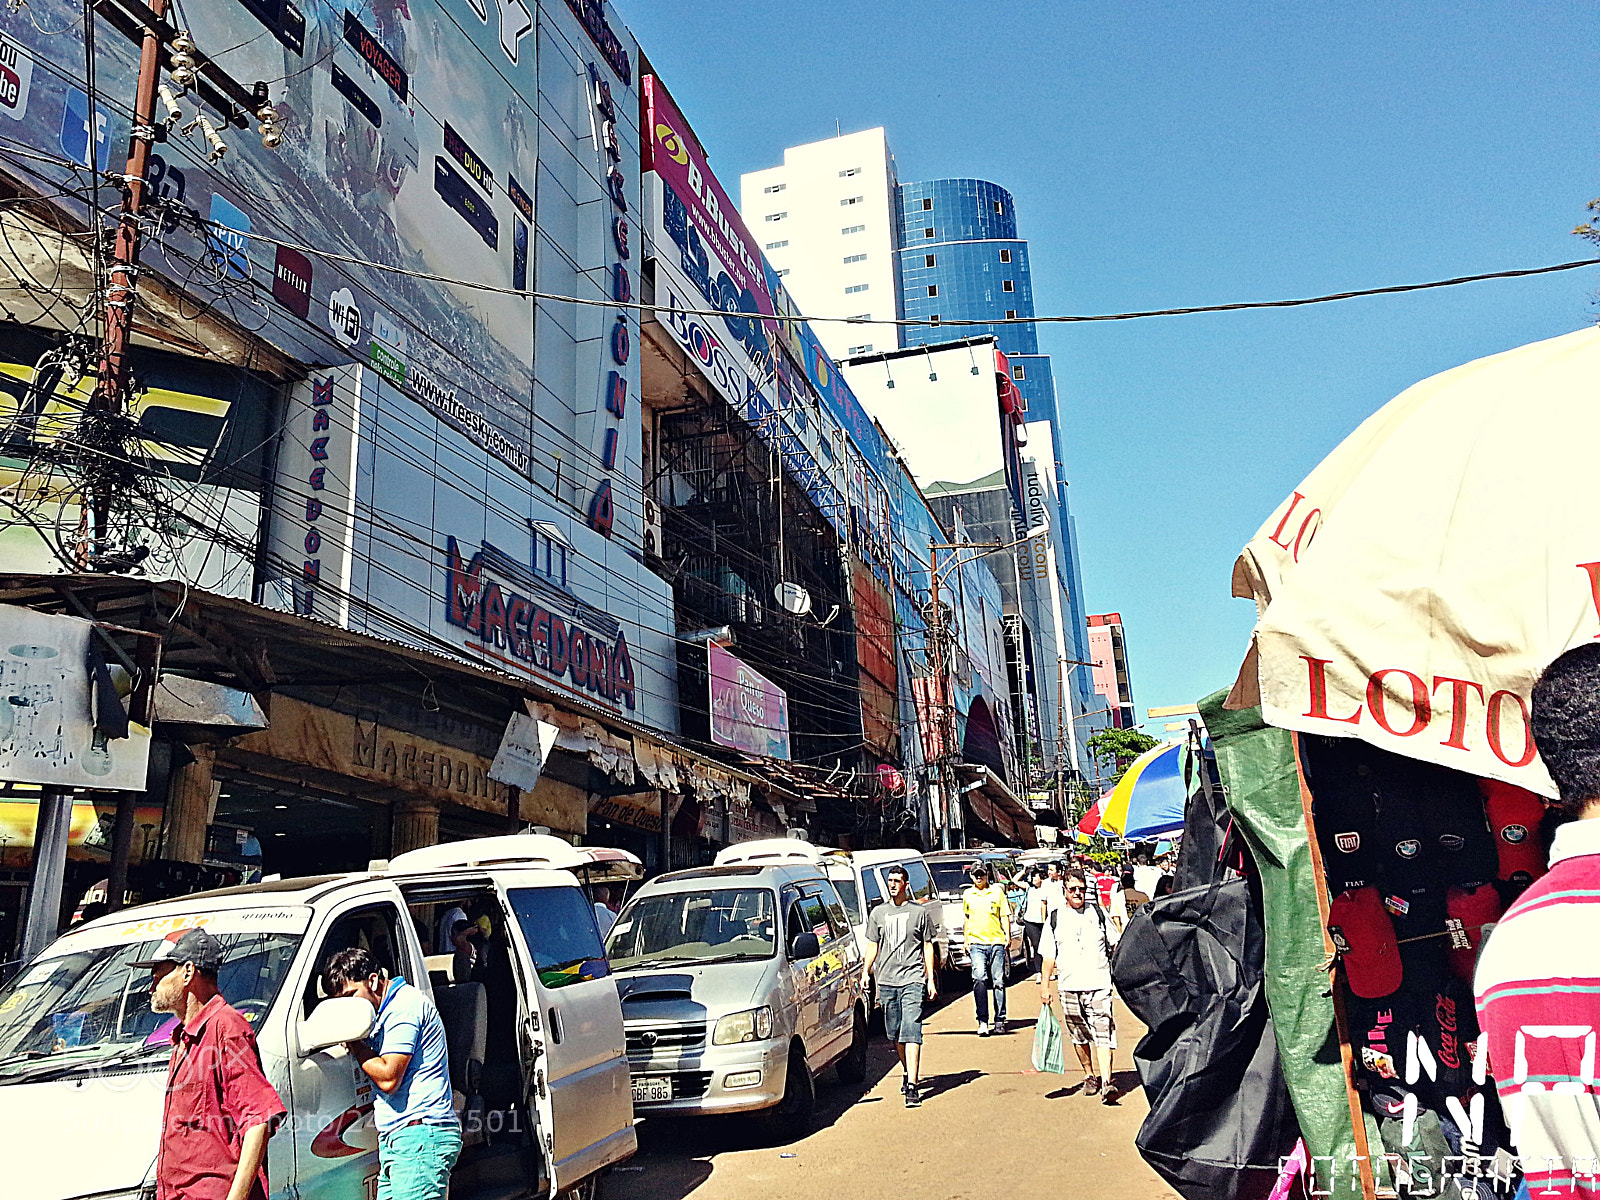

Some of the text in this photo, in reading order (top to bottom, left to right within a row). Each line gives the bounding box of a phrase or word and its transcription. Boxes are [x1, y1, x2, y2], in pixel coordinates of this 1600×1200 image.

[0, 36, 17, 69] ou
[360, 31, 402, 92] VOYAGER
[465, 151, 481, 180] DUO
[483, 171, 493, 193] HD
[277, 264, 308, 294] NETFLIX
[667, 290, 742, 404] BOSS
[411, 367, 529, 474] www.freesky.com.br
[304, 374, 334, 614] MACEDONI
[446, 535, 636, 711] MACEDONIA
[1298, 655, 1538, 768] LOTO
[618, 802, 632, 821] de
[1339, 836, 1358, 849] FIAT
[651, 1086, 668, 1100] 985
